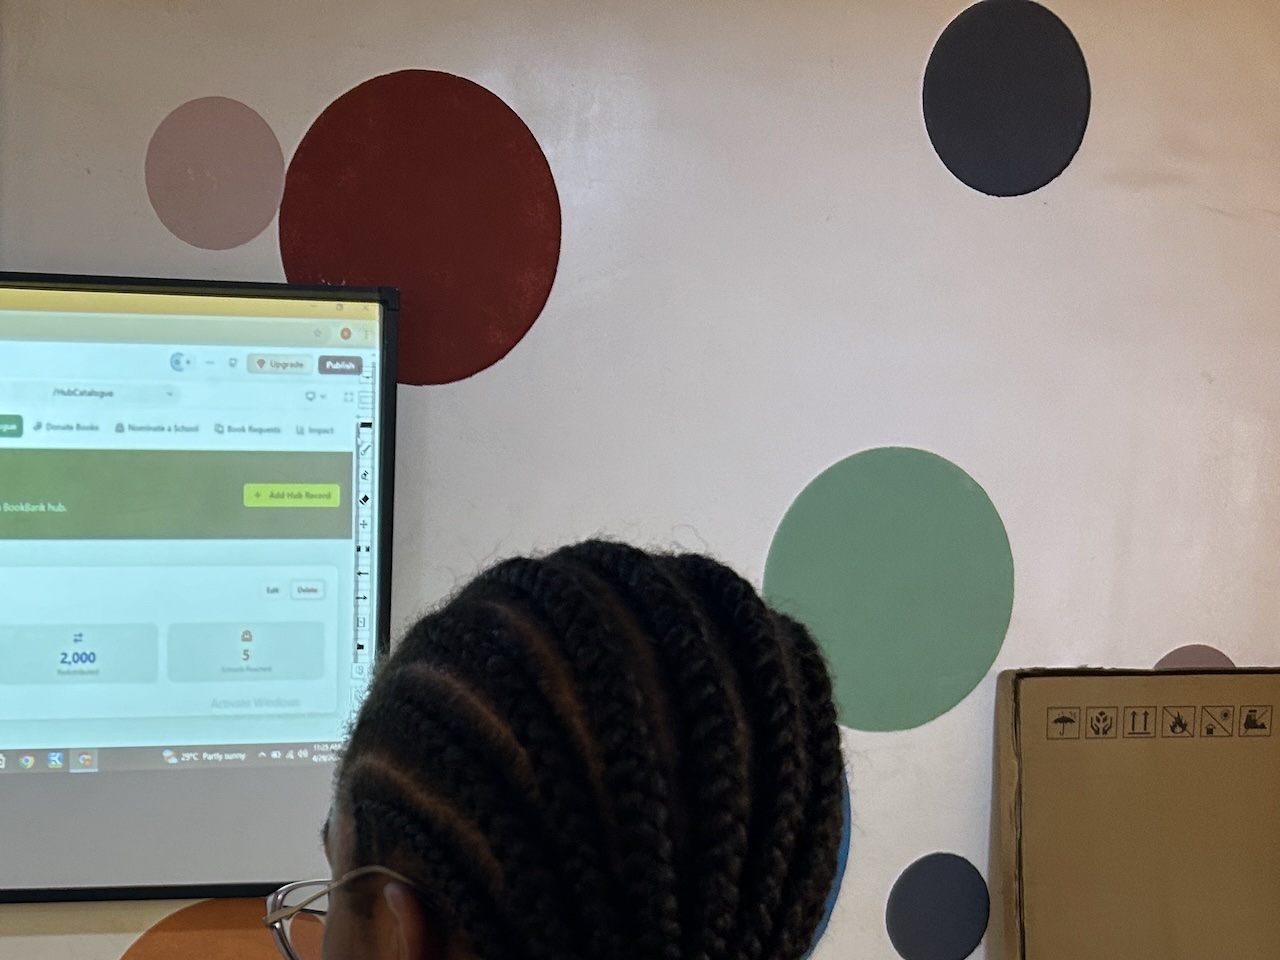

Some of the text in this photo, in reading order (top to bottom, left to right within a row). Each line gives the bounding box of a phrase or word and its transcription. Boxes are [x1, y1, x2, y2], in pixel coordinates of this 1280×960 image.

[270, 360, 355, 370] Upgrade Publish
[53, 388, 114, 399] /HubCatalogue
[46, 423, 100, 432] Donate Books
[128, 424, 166, 433] Nominate
[174, 424, 199, 433] School
[227, 425, 281, 436] Book Requests
[308, 426, 334, 436] Impact
[269, 490, 331, 500] Add Hub Record
[3, 503, 46, 513] BookBank
[47, 503, 67, 513] hub.
[266, 586, 318, 595] Edit Delete
[60, 651, 96, 665] 2,000
[242, 649, 250, 661] 5
[210, 696, 300, 709] Activate Windows
[202, 751, 223, 761] Partly
[224, 752, 246, 762] sunny
